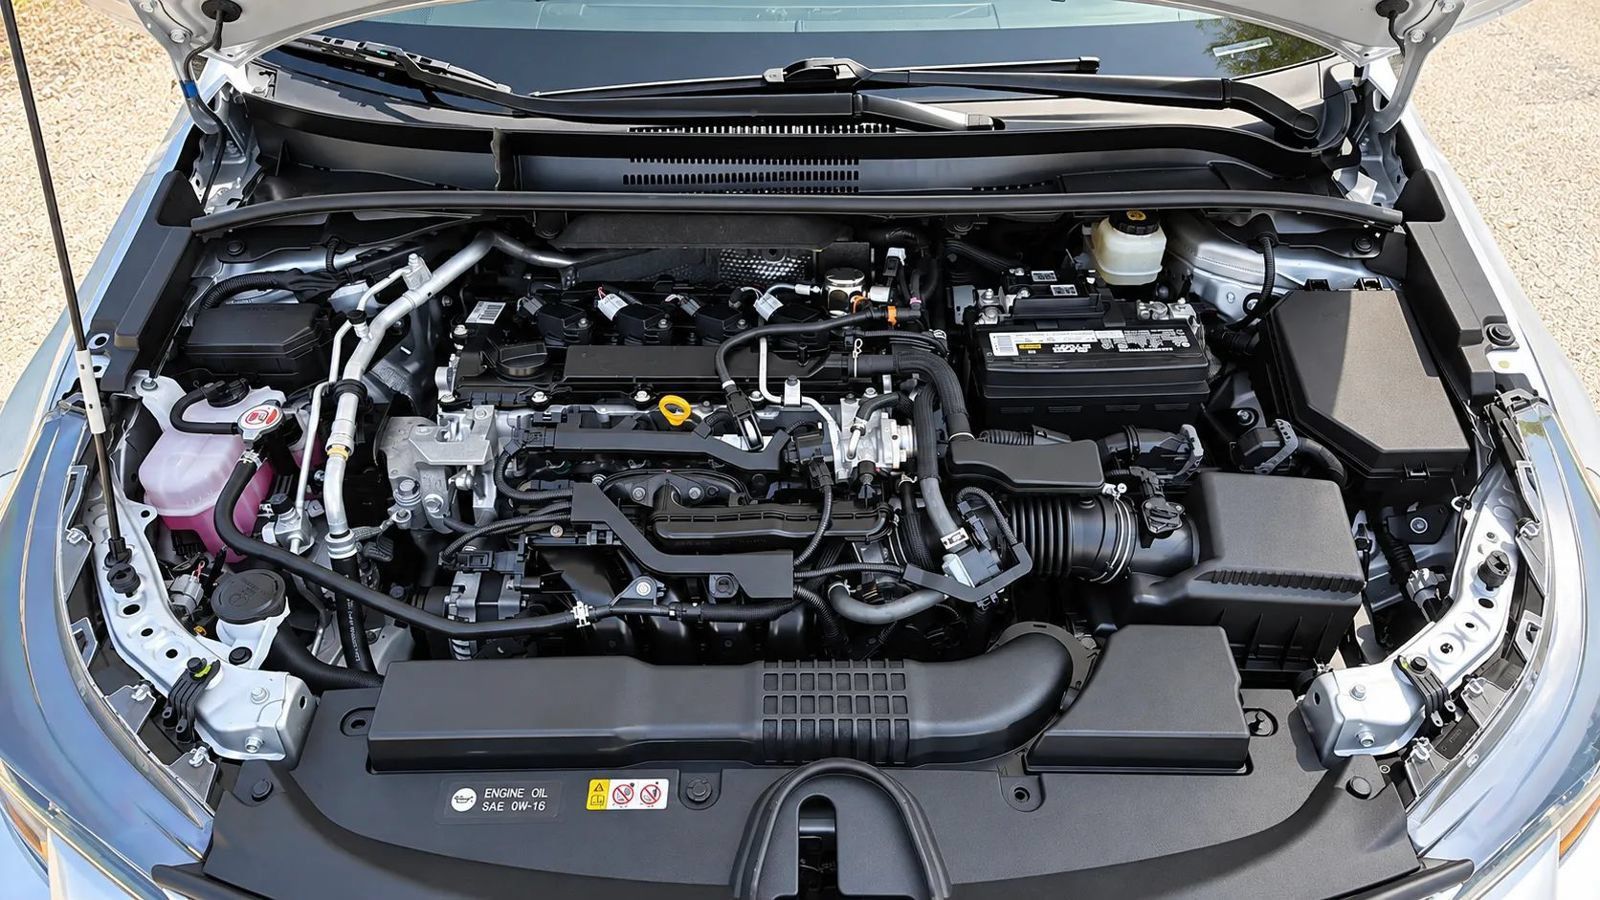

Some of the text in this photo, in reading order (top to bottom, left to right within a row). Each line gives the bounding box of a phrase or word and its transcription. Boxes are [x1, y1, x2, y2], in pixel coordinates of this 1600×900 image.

[484, 788, 548, 798] ENGINE OIL
[482, 801, 546, 811] SAE 0W-16
